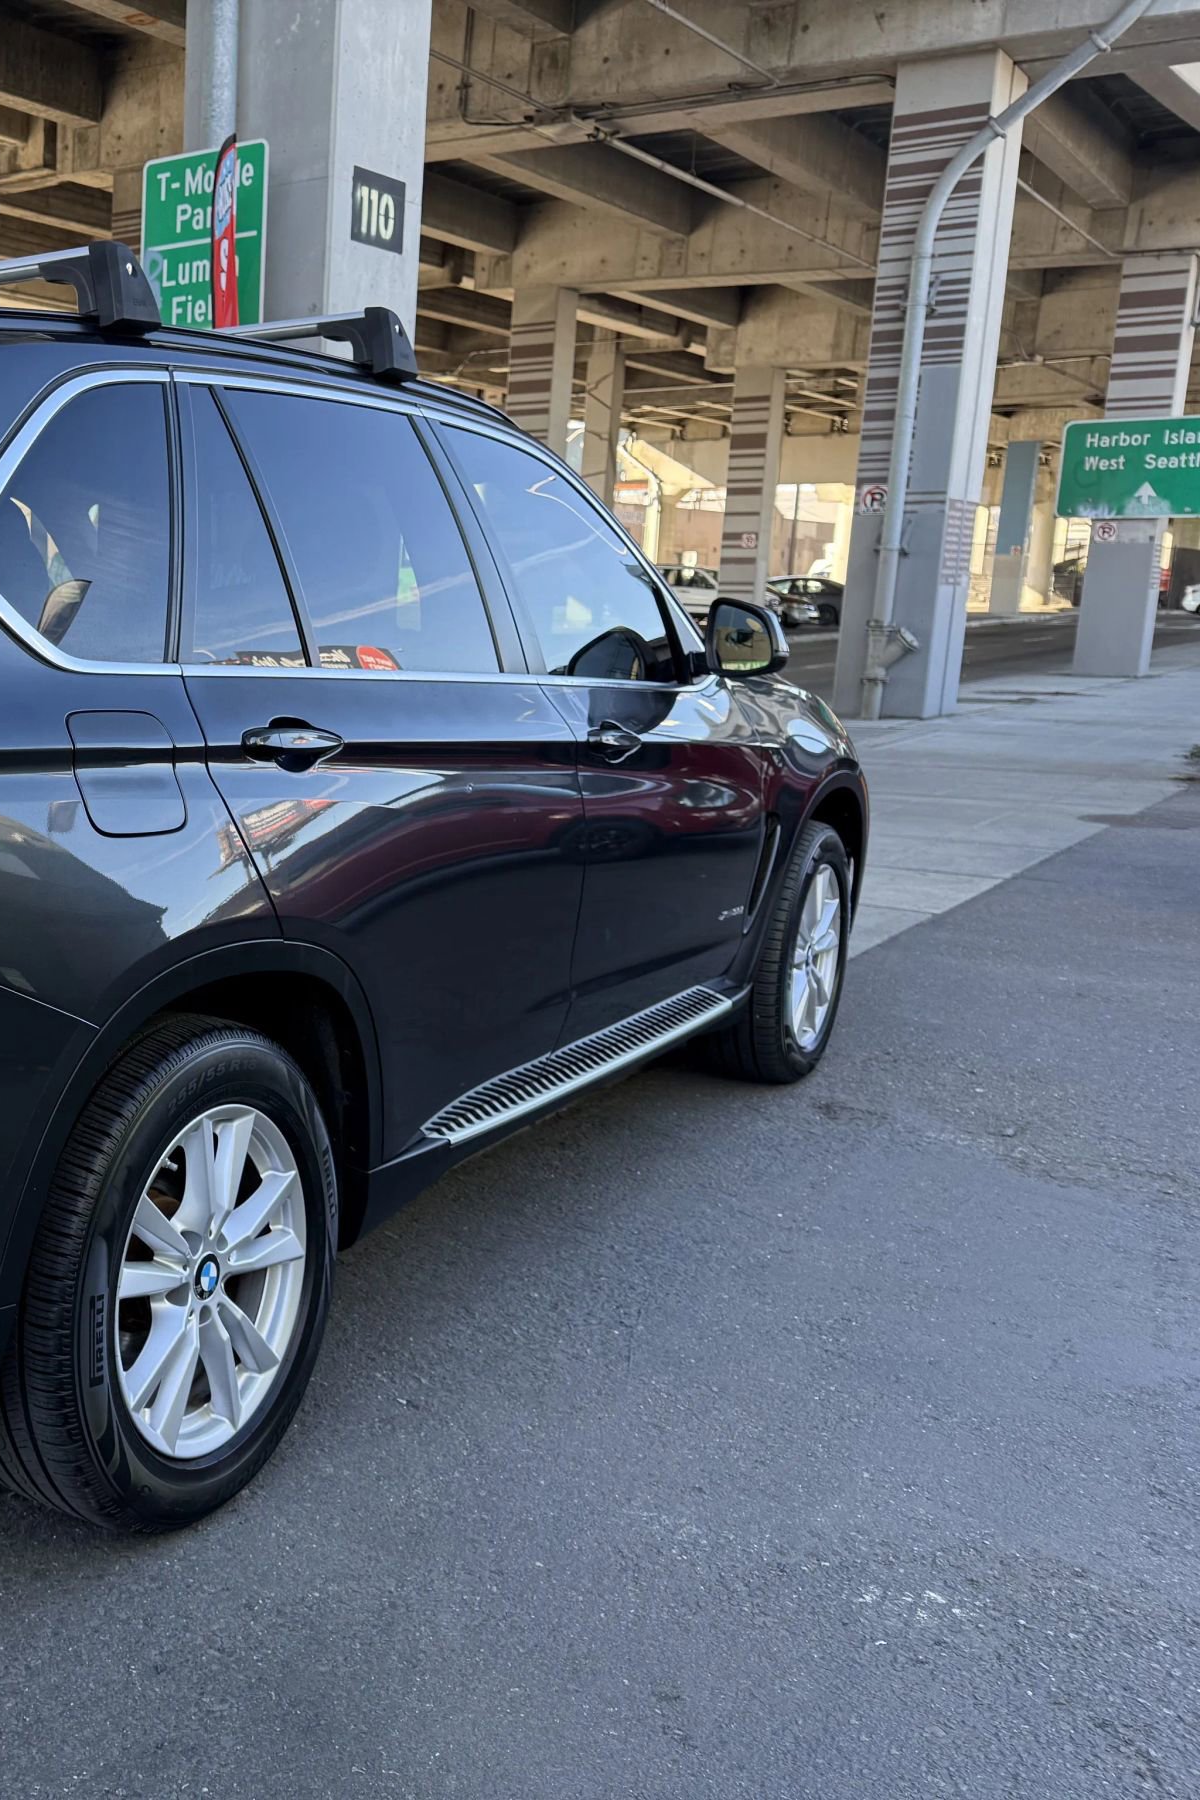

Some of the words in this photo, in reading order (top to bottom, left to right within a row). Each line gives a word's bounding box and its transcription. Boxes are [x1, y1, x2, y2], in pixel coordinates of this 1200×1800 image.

[157, 158, 254, 201] T-Mole
[176, 203, 212, 233] Par
[360, 185, 395, 240] 110
[162, 255, 239, 287] Lum
[171, 293, 212, 325] Fiel
[1085, 432, 1151, 448] Harbor
[1084, 455, 1125, 471] West
[89, 1293, 105, 1388] PIRELLI
